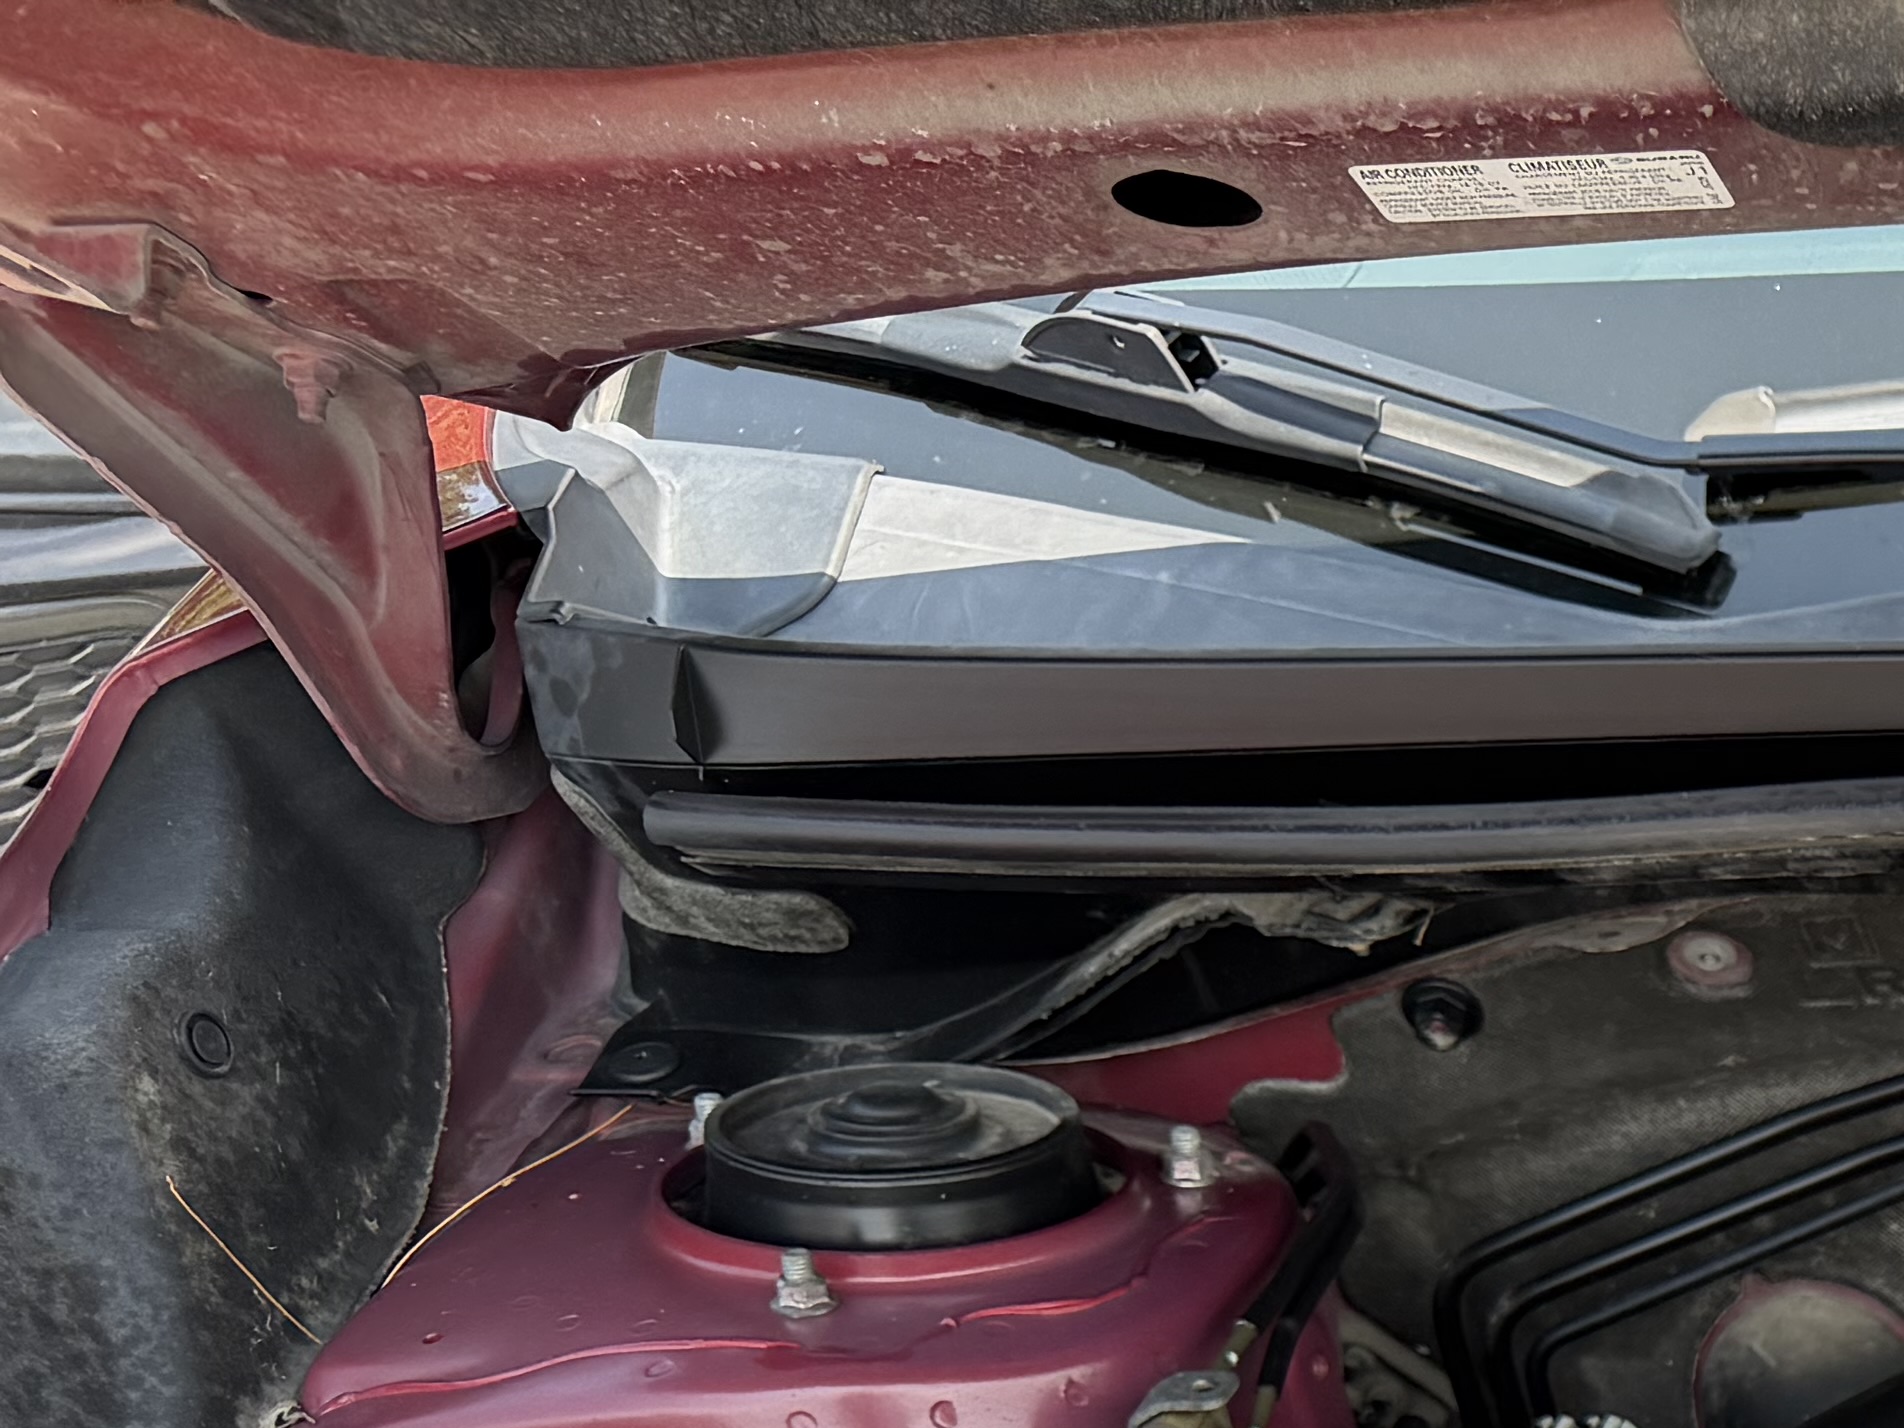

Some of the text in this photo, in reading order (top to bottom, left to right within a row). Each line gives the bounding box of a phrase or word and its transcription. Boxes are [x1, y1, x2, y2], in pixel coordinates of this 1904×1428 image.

[1359, 164, 1483, 180] AIR CONDITIONER
[1508, 158, 1609, 174] CLIMATISEUR
